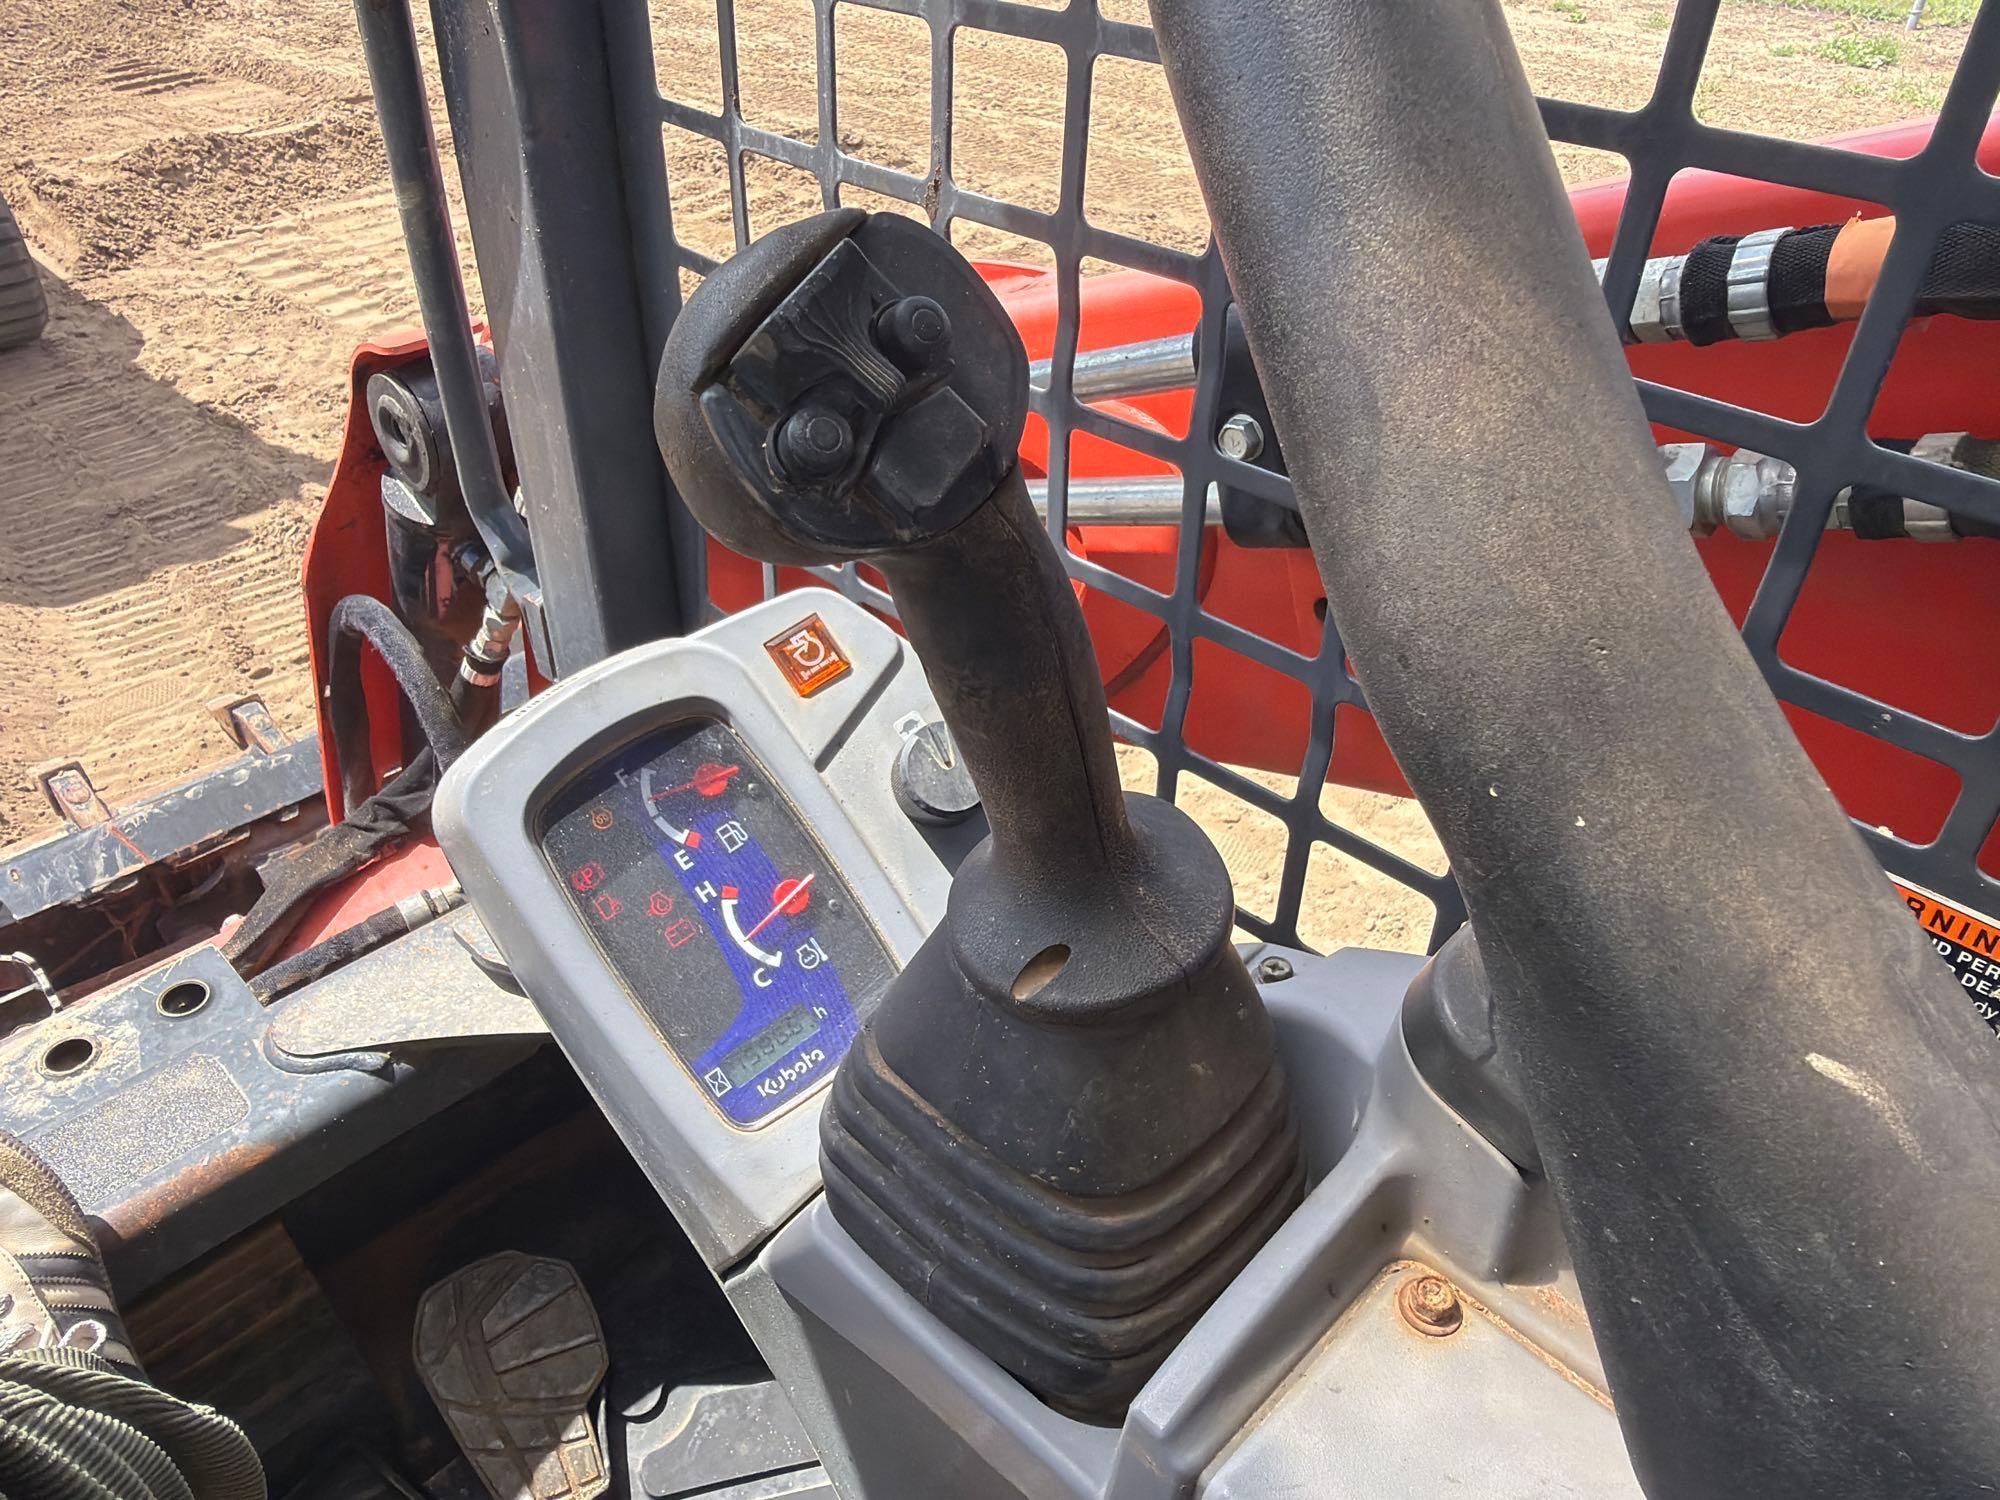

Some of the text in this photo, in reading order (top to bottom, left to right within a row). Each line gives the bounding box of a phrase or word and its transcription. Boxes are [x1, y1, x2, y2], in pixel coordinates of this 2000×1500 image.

[613, 767, 630, 788] F
[673, 848, 695, 871] E
[694, 880, 718, 904] H
[1906, 896, 2000, 955] RNIN
[1956, 951, 2000, 980] PER
[753, 967, 773, 988] C
[812, 1006, 828, 1020] h
[1973, 1001, 2000, 1020] dy
[756, 1048, 826, 1098] Kubota
